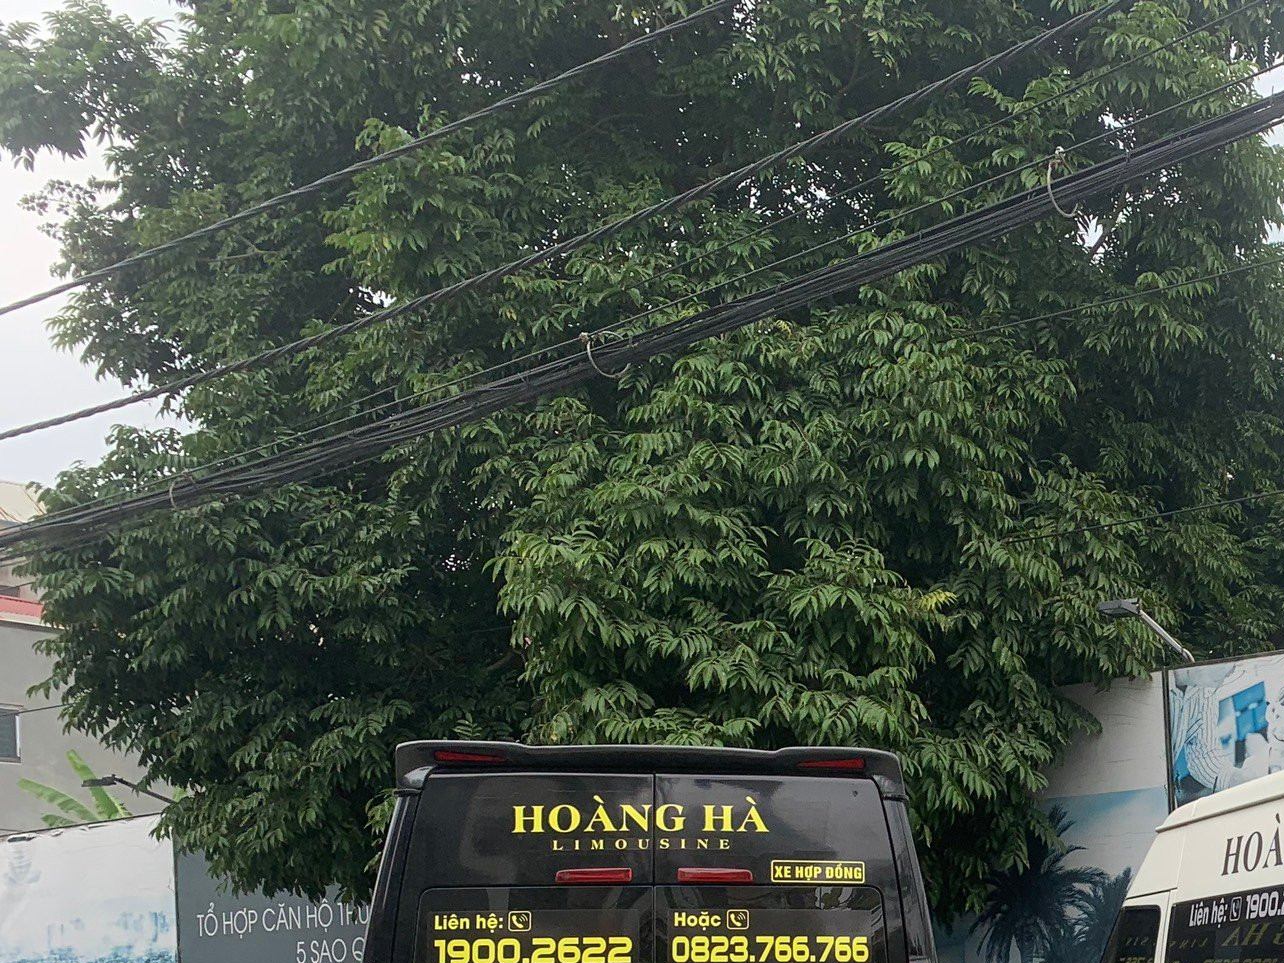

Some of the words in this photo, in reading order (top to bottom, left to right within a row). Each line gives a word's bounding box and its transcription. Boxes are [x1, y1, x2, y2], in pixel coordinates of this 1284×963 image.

[512, 795, 686, 833] HOÀNG
[702, 796, 769, 832] HÀ
[553, 838, 730, 850] LIMOUSINE
[774, 866, 791, 878] XE
[795, 865, 822, 881] HỢP
[197, 902, 218, 936] TỔ
[222, 908, 258, 939] HỢP
[262, 903, 301, 932] CĂN
[306, 899, 333, 933] HỘ
[434, 913, 471, 930] Liên
[475, 913, 504, 934] hệ:
[674, 911, 721, 931] Hoặc
[1189, 901, 1209, 927] Liên
[1211, 898, 1229, 928] hệ:
[310, 938, 347, 963] SAO
[672, 935, 869, 963] 0823.766.766
